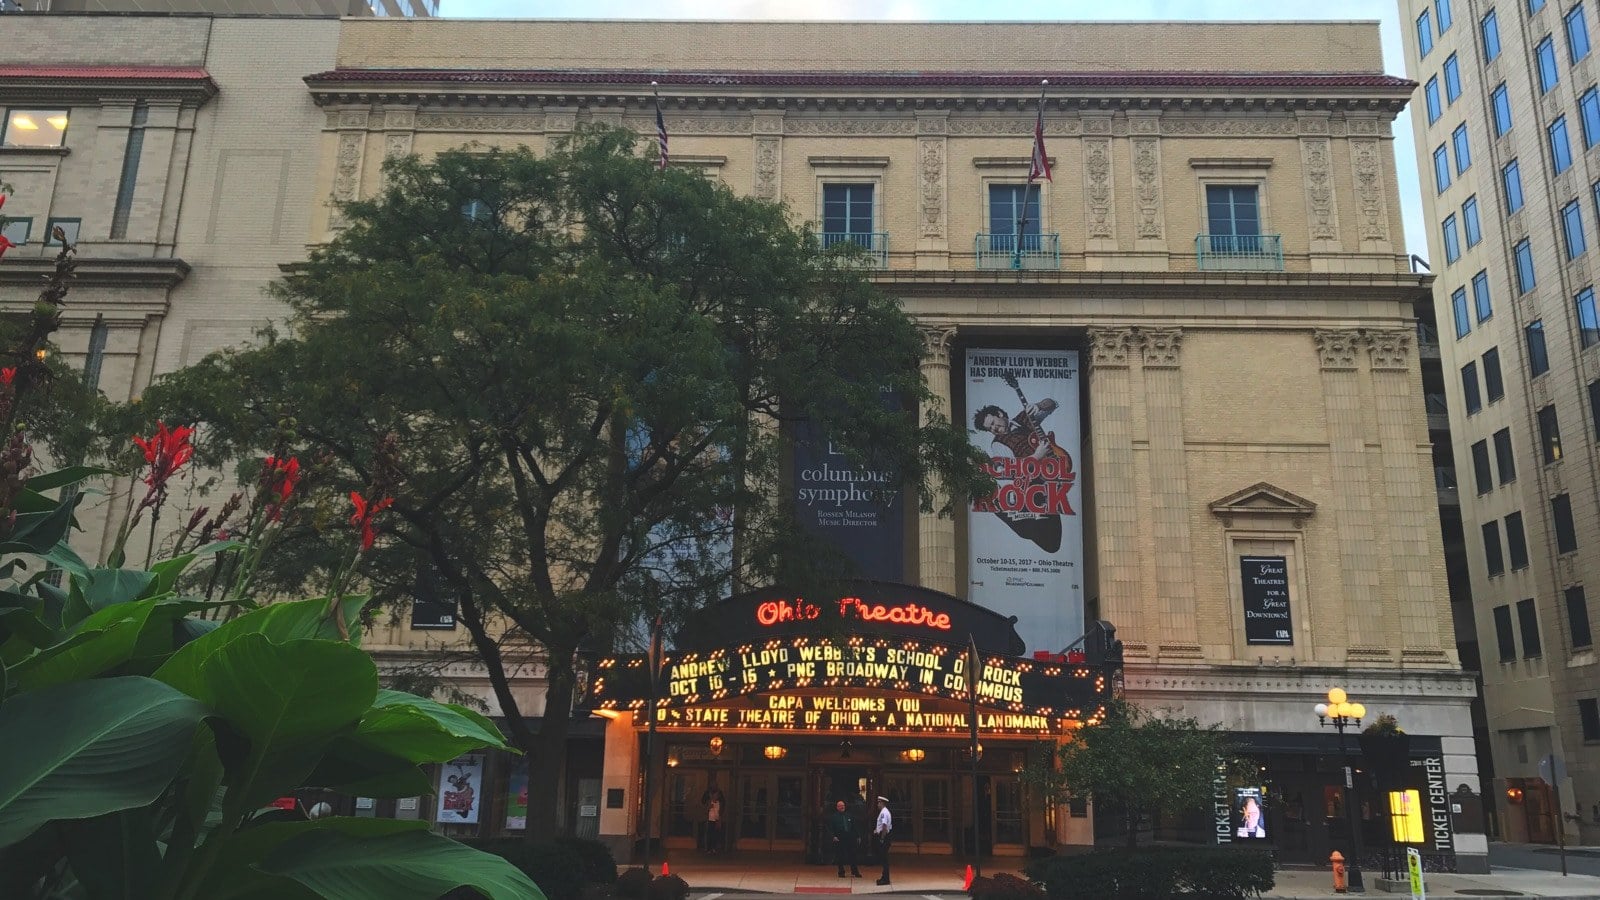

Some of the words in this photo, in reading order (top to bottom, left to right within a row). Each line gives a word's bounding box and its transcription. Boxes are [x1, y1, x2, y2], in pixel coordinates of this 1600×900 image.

[970, 367, 986, 378] HAS
[987, 367, 1031, 379] BROADWAY
[1008, 357, 1034, 367] LLOYD
[1035, 357, 1069, 368] WEBBER
[798, 483, 898, 508] sympho
[976, 557, 999, 565] October
[1052, 560, 1074, 568] Theatre
[757, 599, 821, 625] Ohio
[836, 597, 951, 628] Theatre
[742, 648, 789, 668] LLOYD
[799, 646, 876, 662] WEBBR'S
[886, 648, 943, 671] SCHOOL
[983, 665, 1022, 687] ROCK
[670, 679, 698, 697] OCT
[787, 662, 816, 678] PNC
[826, 662, 909, 681] BROADWAY
[919, 670, 934, 685] IN
[944, 673, 1024, 703] COMBUS
[769, 696, 804, 709] CAPA
[813, 698, 886, 711] WELCOMES
[895, 699, 920, 711] YOU
[685, 708, 730, 721] STATE
[738, 709, 796, 723] THEATRE
[805, 711, 822, 724] OF
[831, 711, 860, 725] OHIO
[887, 713, 897, 725] A
[906, 713, 969, 727] NATIONAL
[978, 714, 1049, 729] LANDMARK
[1426, 757, 1446, 803] CENTER
[1430, 807, 1451, 850] TICKET
